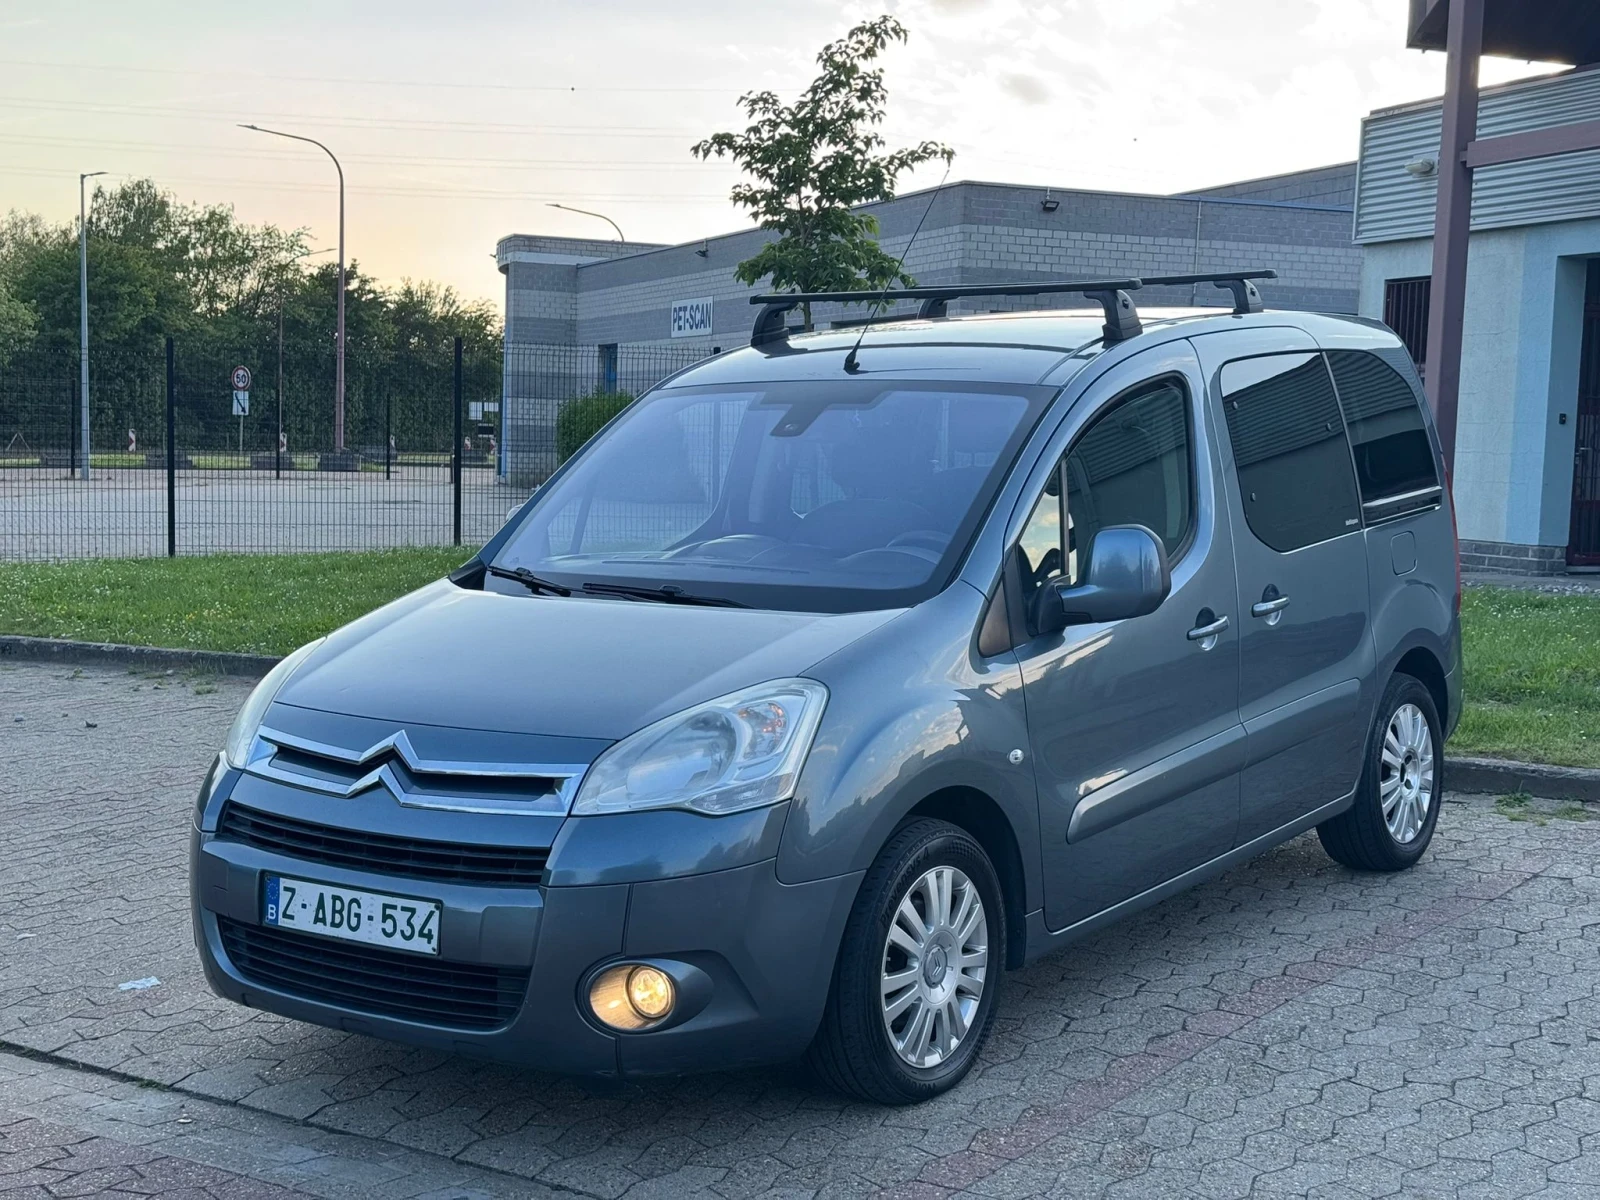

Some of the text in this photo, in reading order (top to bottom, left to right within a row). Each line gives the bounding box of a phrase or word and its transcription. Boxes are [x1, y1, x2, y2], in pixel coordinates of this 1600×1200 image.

[672, 302, 712, 332] PET-SCAN
[235, 373, 247, 384] 50
[268, 904, 277, 920] B
